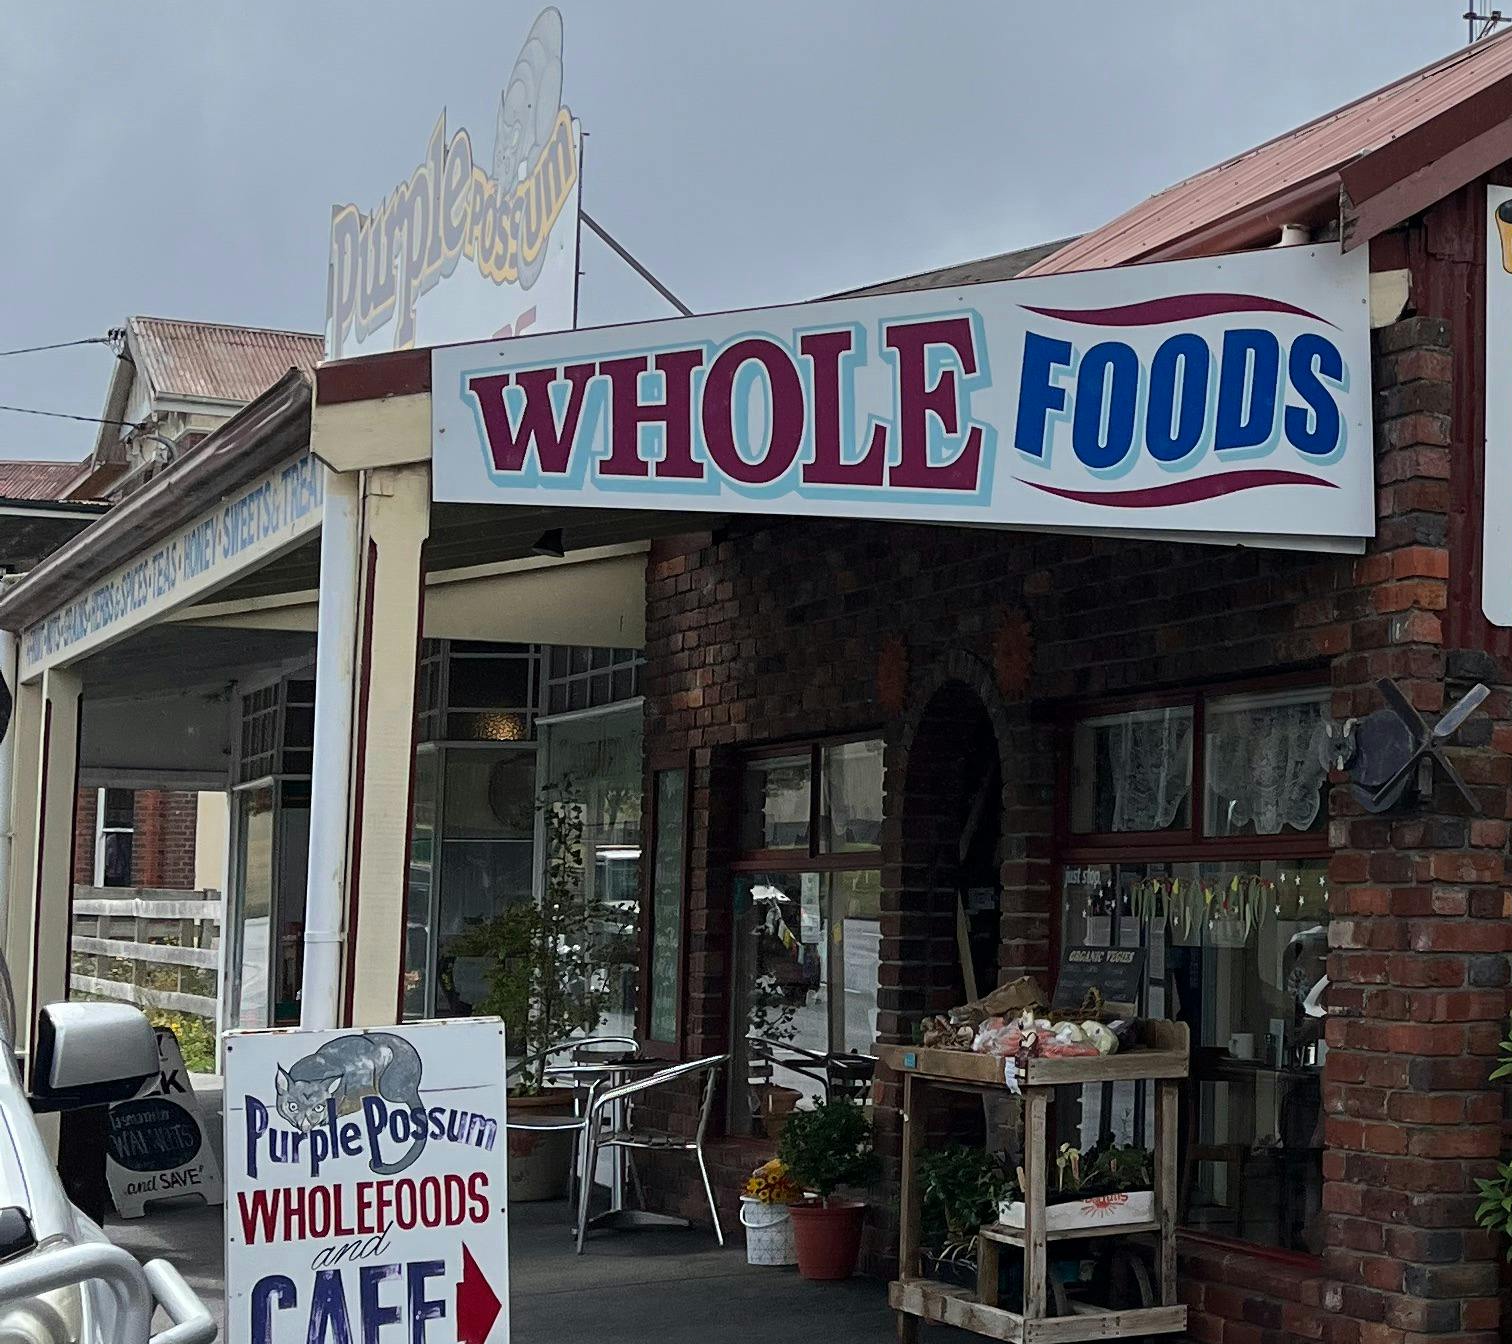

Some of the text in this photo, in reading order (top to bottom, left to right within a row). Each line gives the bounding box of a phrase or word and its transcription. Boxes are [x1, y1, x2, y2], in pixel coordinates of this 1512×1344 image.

[330, 108, 472, 360] Purple
[468, 317, 1344, 491] WHOLE FOODS
[153, 543, 177, 599] TEAS
[183, 514, 219, 581] HONEY
[223, 480, 272, 559] SWEETS
[1068, 950, 1136, 964] ORGANIC VEGIES
[244, 1094, 498, 1180] Purple Possum
[127, 1175, 159, 1196] and
[237, 1171, 490, 1246] WHOLEFOODS
[310, 1220, 394, 1271] and
